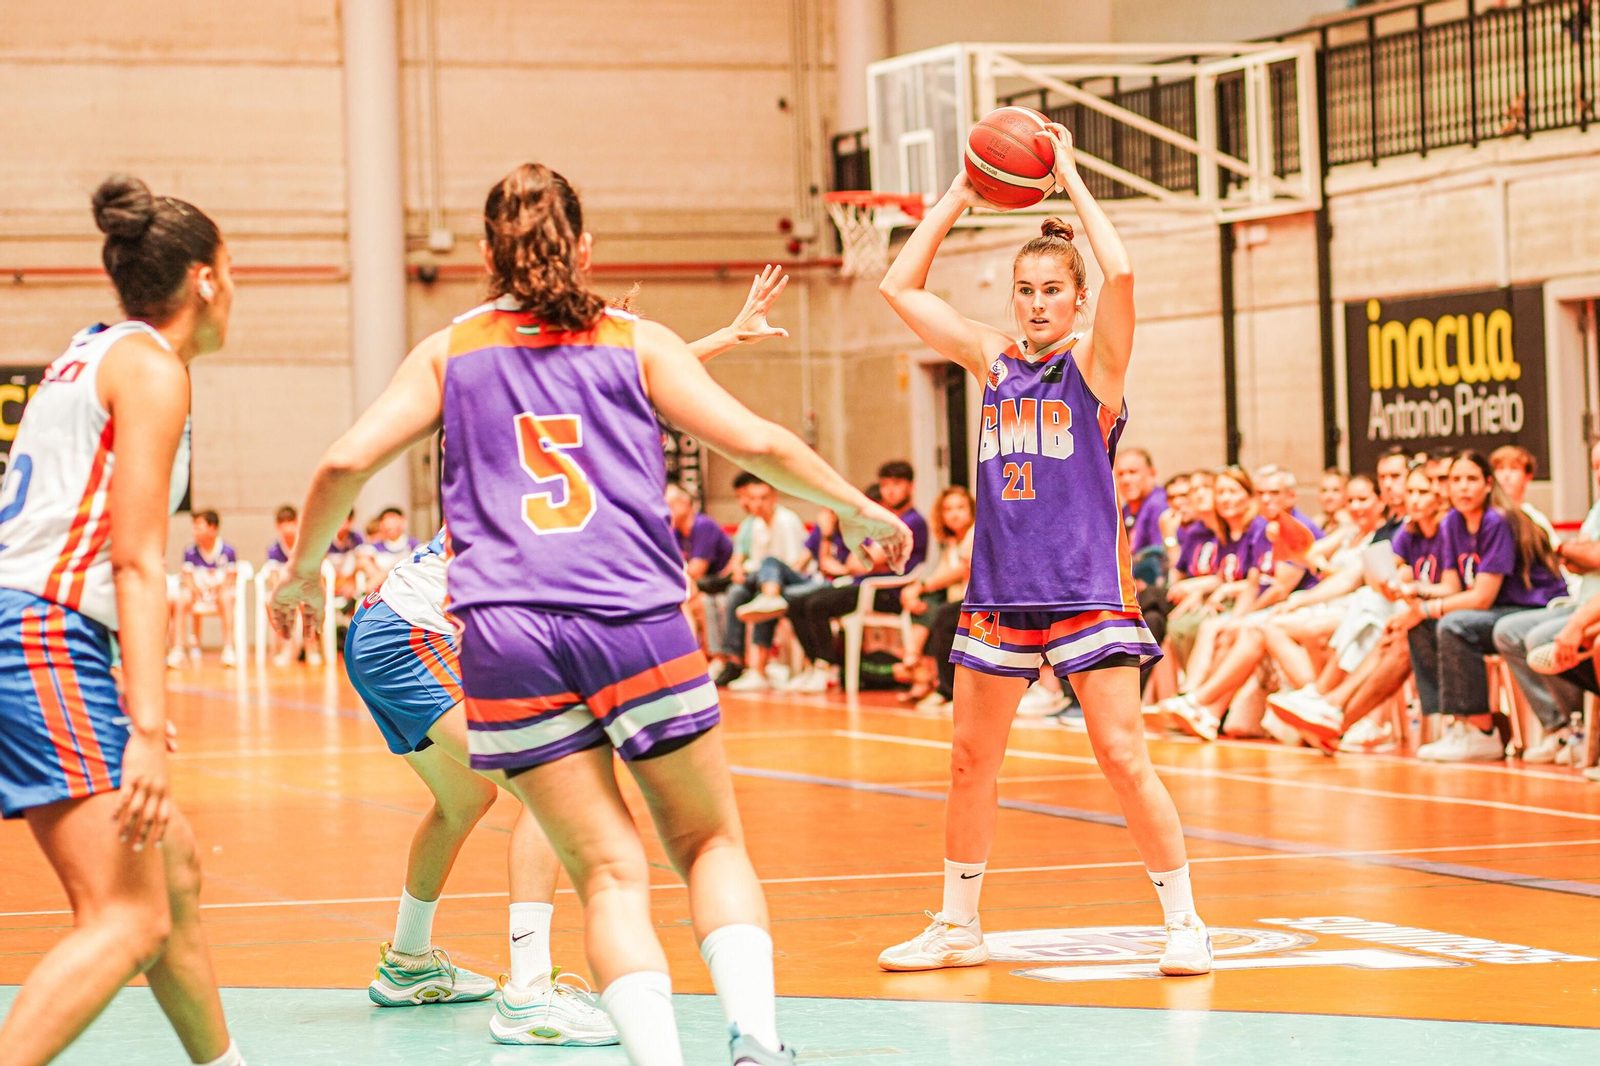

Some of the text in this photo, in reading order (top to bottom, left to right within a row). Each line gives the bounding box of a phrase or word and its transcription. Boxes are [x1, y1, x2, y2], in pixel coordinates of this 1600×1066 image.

[979, 397, 1074, 463] GMB
[1367, 383, 1524, 441] Antonio Prieto
[513, 411, 598, 535] 5
[1001, 461, 1036, 501] 21
